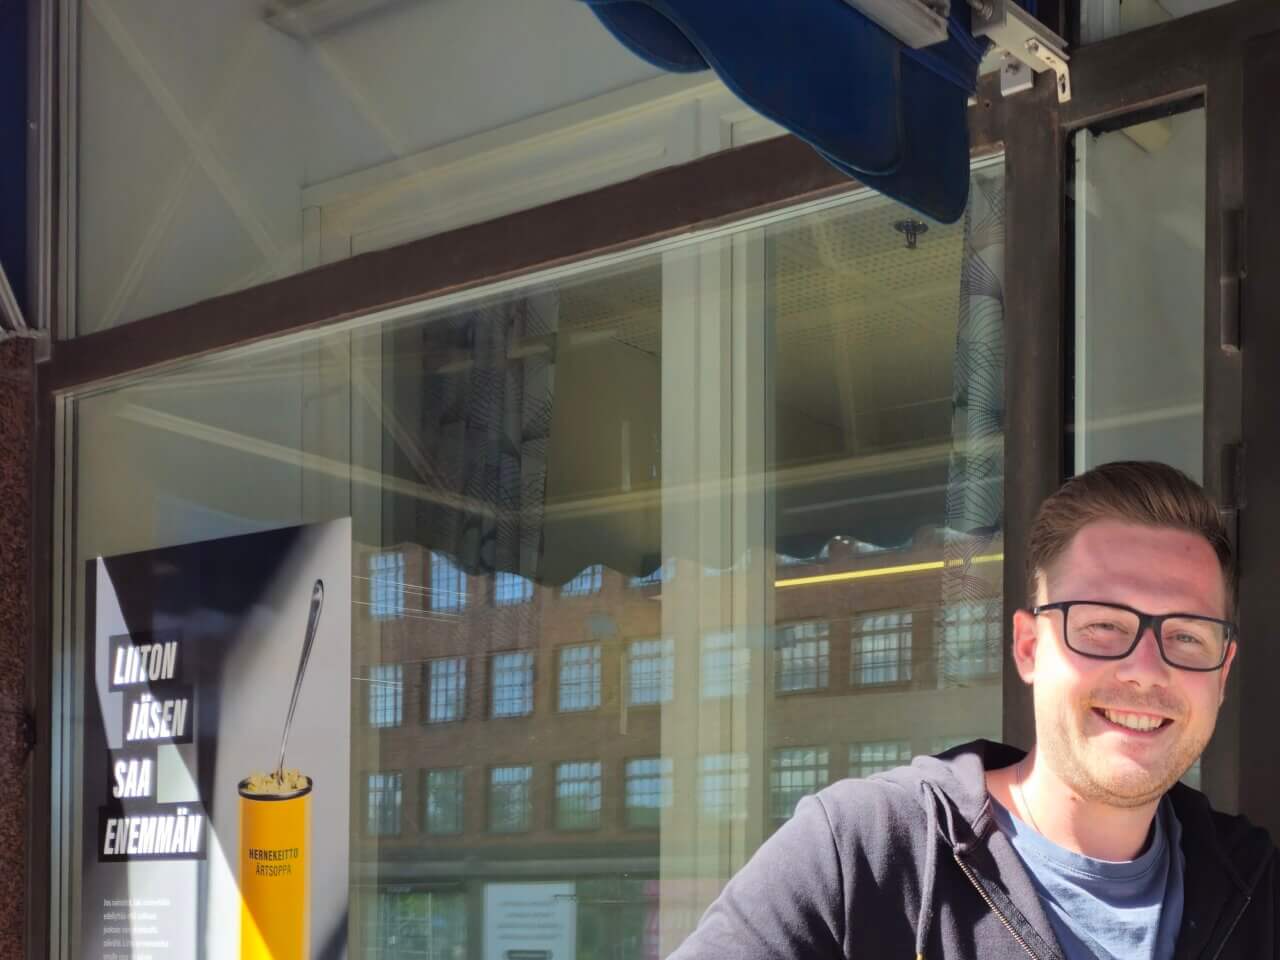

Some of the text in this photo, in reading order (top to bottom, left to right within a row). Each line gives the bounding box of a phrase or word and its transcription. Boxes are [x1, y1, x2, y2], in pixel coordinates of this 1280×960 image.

[113, 641, 178, 685] LIITON
[126, 692, 188, 741] JÄSEN
[112, 757, 153, 799] SAA
[103, 806, 203, 855] ENEMMÄN
[248, 847, 300, 861] HERNEKEITTO
